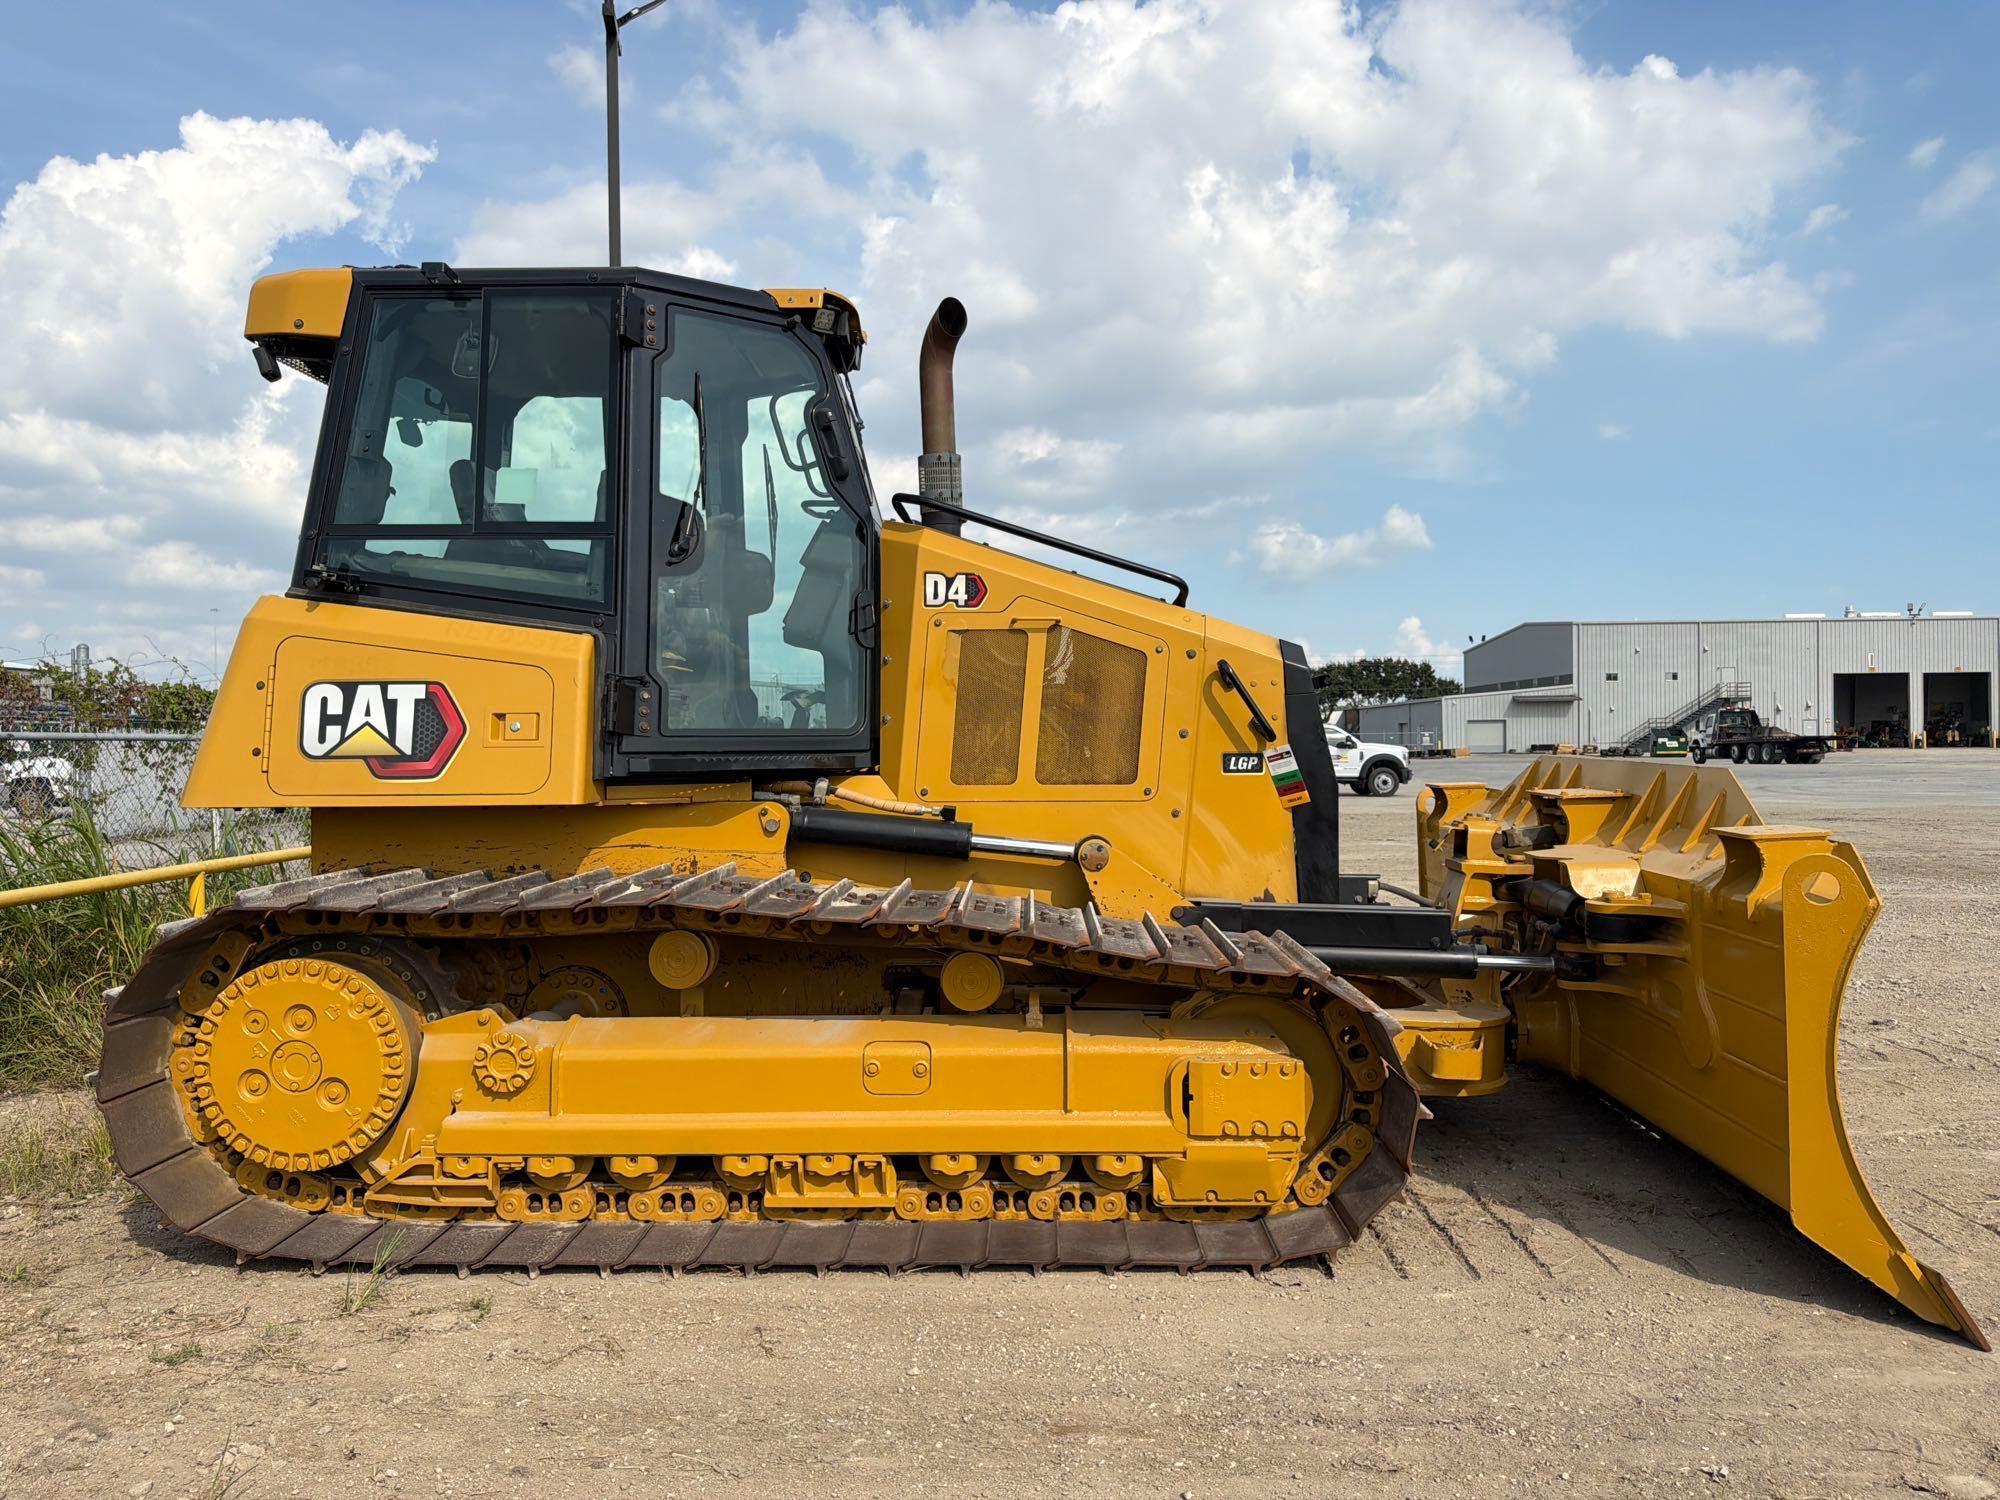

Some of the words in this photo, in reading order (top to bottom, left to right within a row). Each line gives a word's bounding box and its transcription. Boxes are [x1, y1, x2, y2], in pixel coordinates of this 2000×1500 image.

[925, 573, 968, 606] D4
[302, 683, 427, 757] CAT
[1229, 756, 1259, 770] LGP
